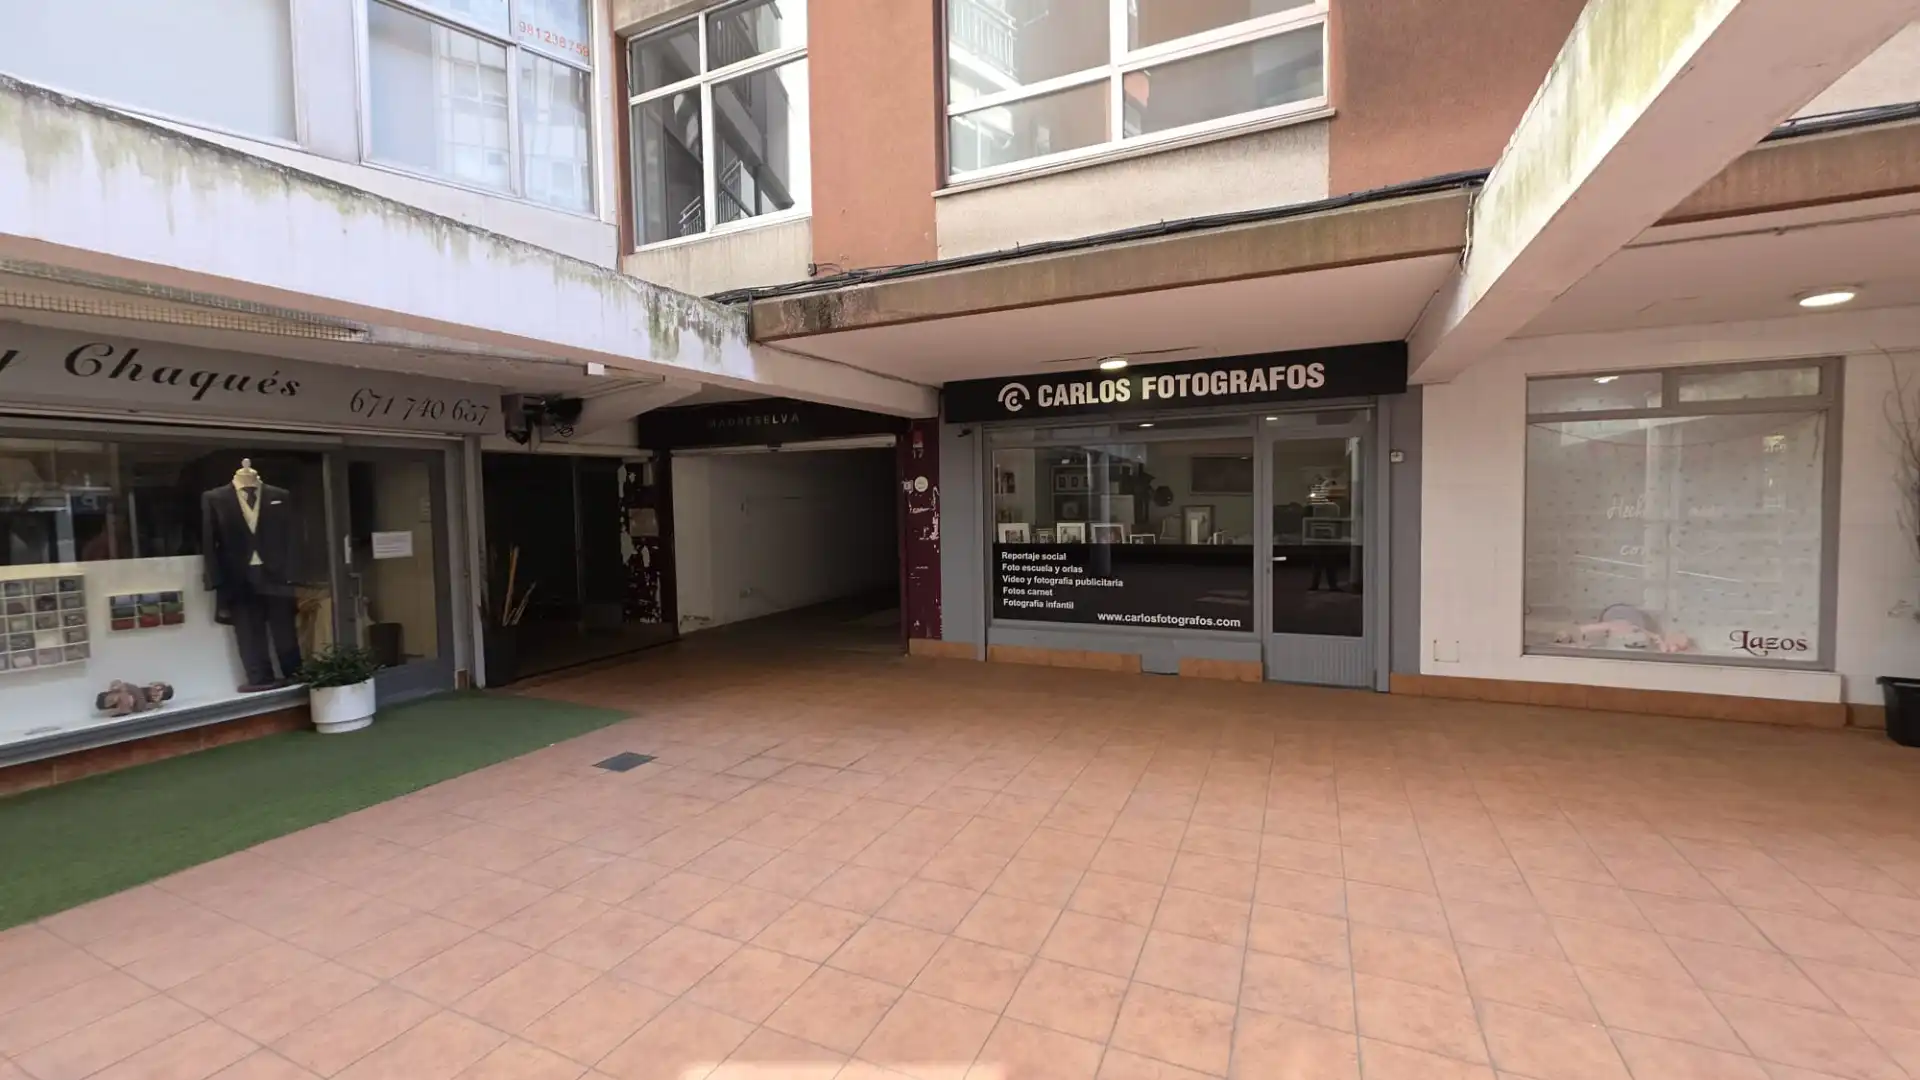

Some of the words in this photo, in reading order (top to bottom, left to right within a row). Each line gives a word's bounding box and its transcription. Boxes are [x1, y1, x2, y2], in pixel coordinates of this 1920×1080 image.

[64, 342, 301, 401] Chaqués
[1037, 377, 1131, 408] CARLOS
[1142, 363, 1326, 401] FOTOGRAFOS
[350, 387, 395, 418] 671
[403, 396, 445, 421] 740
[1001, 551, 1041, 562] Reportaje
[1041, 552, 1067, 561] social
[1002, 563, 1021, 572] Foto
[1022, 564, 1053, 573] escuela
[1061, 565, 1084, 574] orlas
[1003, 586, 1026, 596] Fotos
[1027, 588, 1053, 597] carnet
[1045, 599, 1075, 610] infantil
[1097, 612, 1242, 628] www.carlosfotografos.com
[1729, 629, 1808, 657] Lazos
